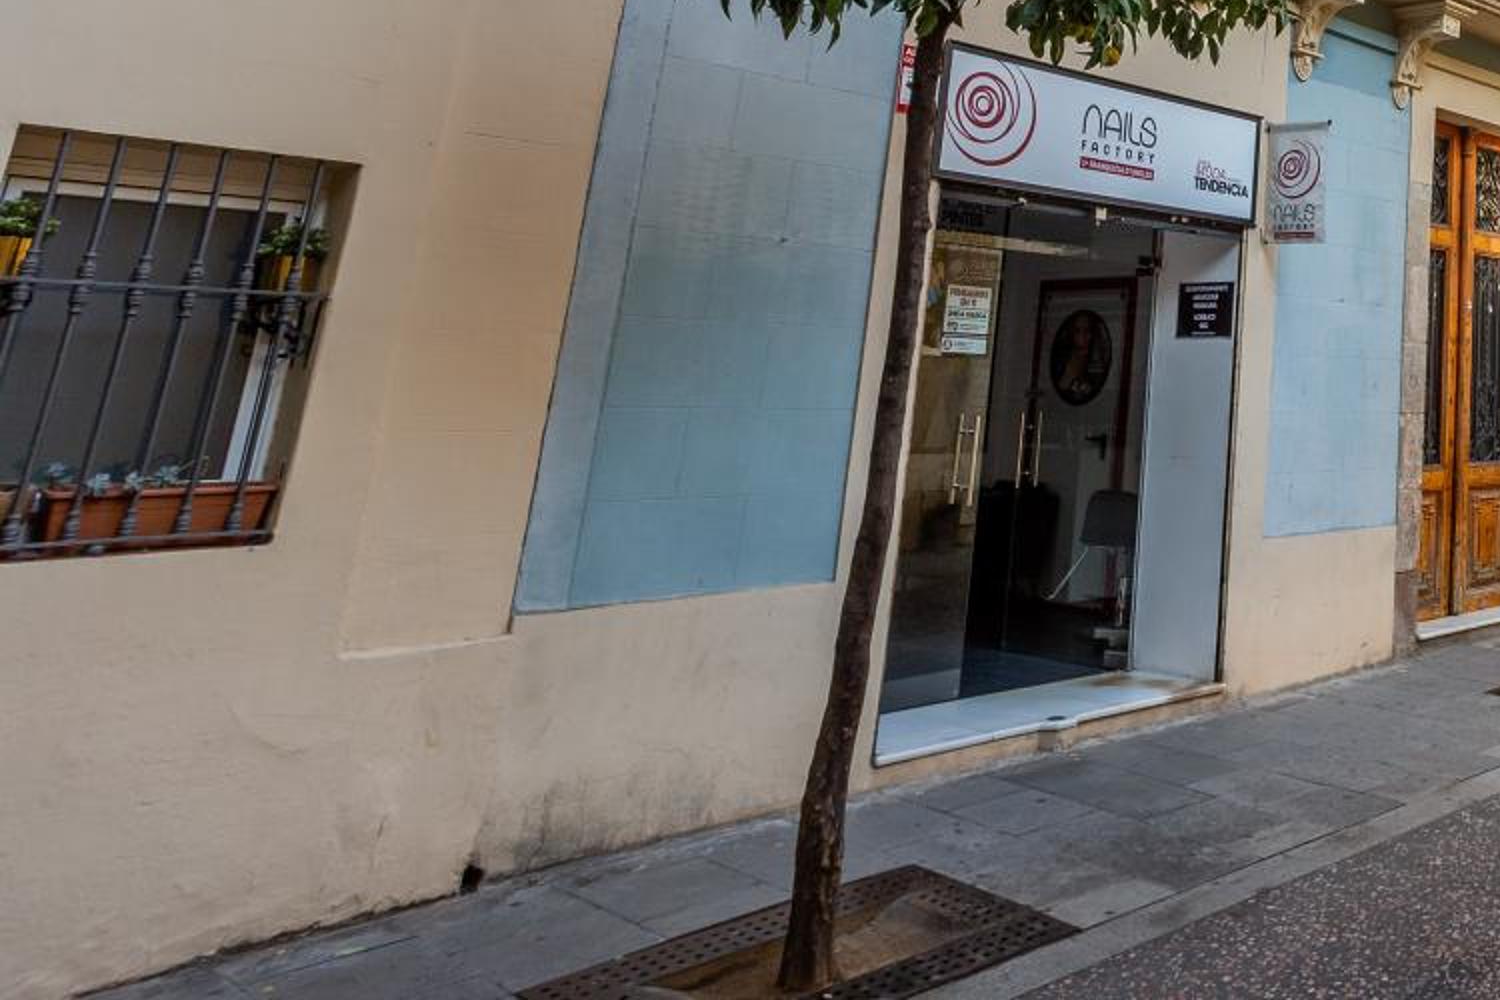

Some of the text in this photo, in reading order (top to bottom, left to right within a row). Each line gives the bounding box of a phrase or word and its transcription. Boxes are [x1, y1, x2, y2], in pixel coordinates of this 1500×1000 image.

[1082, 104, 1157, 149] NAILS
[1081, 139, 1155, 164] FACTORY
[1193, 175, 1249, 198] TENDENCIA
